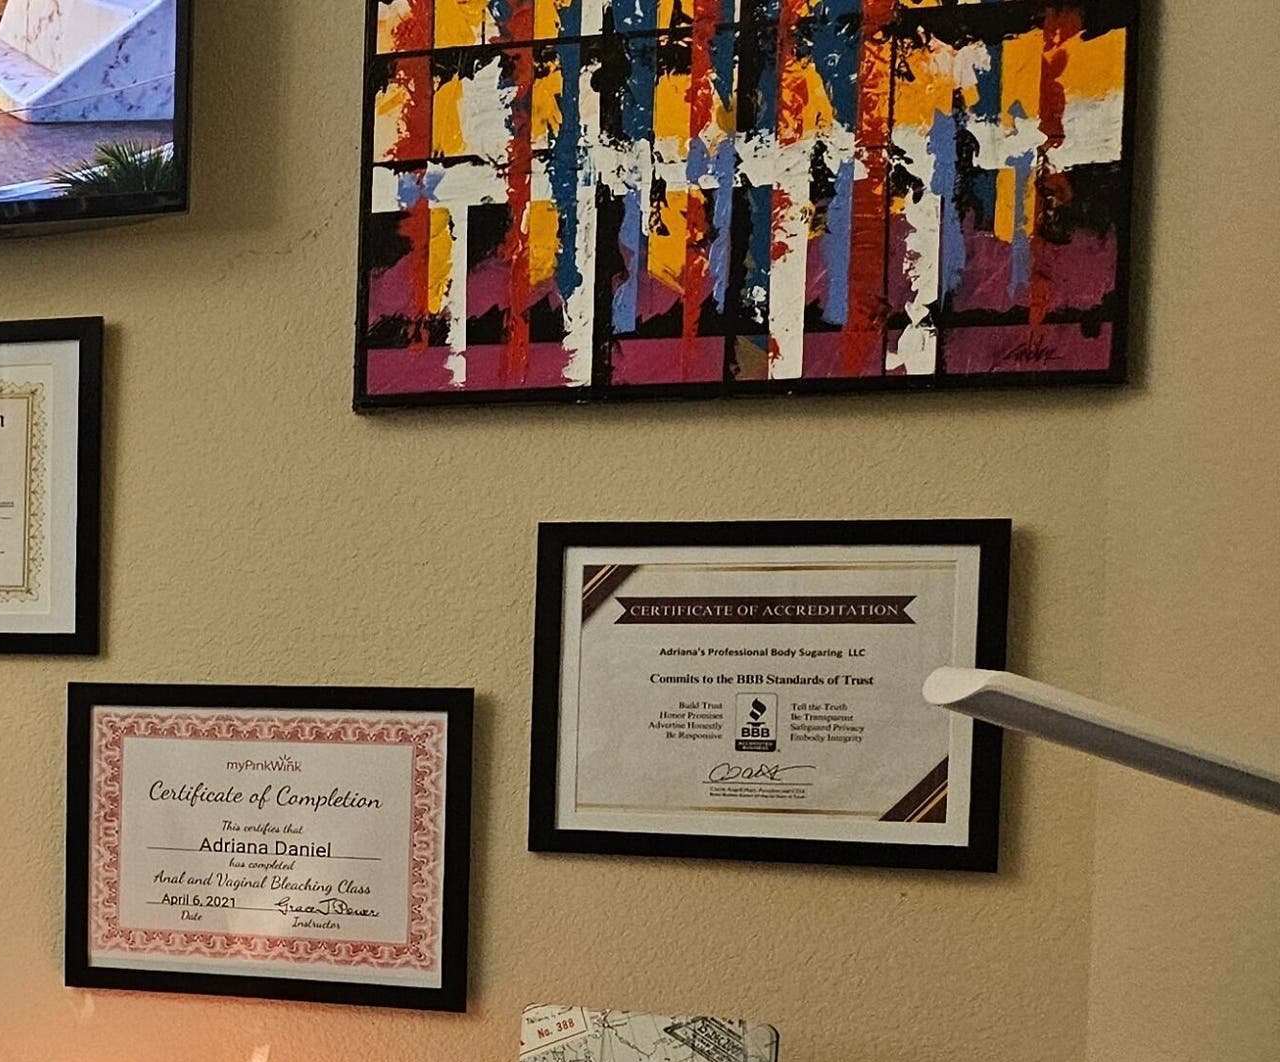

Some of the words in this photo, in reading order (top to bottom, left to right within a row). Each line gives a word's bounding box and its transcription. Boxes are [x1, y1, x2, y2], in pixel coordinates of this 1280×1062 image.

[630, 604, 733, 617] CERTIFICATE
[737, 604, 758, 616] OF
[762, 604, 899, 616] ACCREDITATION
[659, 647, 706, 657] Adriana's
[708, 647, 768, 657] Professional
[771, 647, 796, 658] Body
[799, 647, 843, 659] Sugaring
[848, 648, 866, 657] LLC
[649, 673, 700, 684] Commits
[702, 674, 714, 684] to
[716, 673, 734, 684] the
[736, 673, 764, 685] BBB
[766, 673, 825, 685] Standards
[827, 673, 840, 685] of
[842, 674, 874, 685] Trust
[791, 703, 806, 711] Tell
[808, 703, 820, 711] the
[824, 703, 848, 711] Truth
[660, 711, 685, 719] Honor
[688, 711, 723, 719] Promises
[804, 713, 853, 722] Transparent
[688, 722, 722, 731] Honestly
[741, 727, 770, 738] BBB
[790, 723, 831, 733] Safeguard
[833, 723, 864, 734] Privacy
[678, 732, 722, 740] Responsive
[827, 733, 862, 743] Integrity
[226, 757, 301, 772] myPinkWink
[149, 780, 243, 807] Certificate
[249, 784, 271, 810] of
[277, 785, 383, 811] Completion
[222, 820, 241, 832] This
[243, 823, 280, 835] certifies
[282, 824, 303, 834] that
[199, 837, 268, 854] Adriana
[275, 841, 331, 857] Daniel
[229, 858, 246, 869] has
[248, 860, 295, 871] completed
[153, 870, 184, 885] Anal
[187, 872, 213, 886] and
[216, 873, 265, 891] Vaginal
[270, 876, 332, 894] Bleaching
[337, 880, 371, 895] Class
[161, 893, 189, 905] April
[193, 896, 204, 907] 6,
[207, 897, 236, 908] 2021
[181, 911, 203, 921] Date
[291, 916, 341, 930] Instructor
[537, 1028, 553, 1039] No.
[556, 1018, 575, 1032] 388
